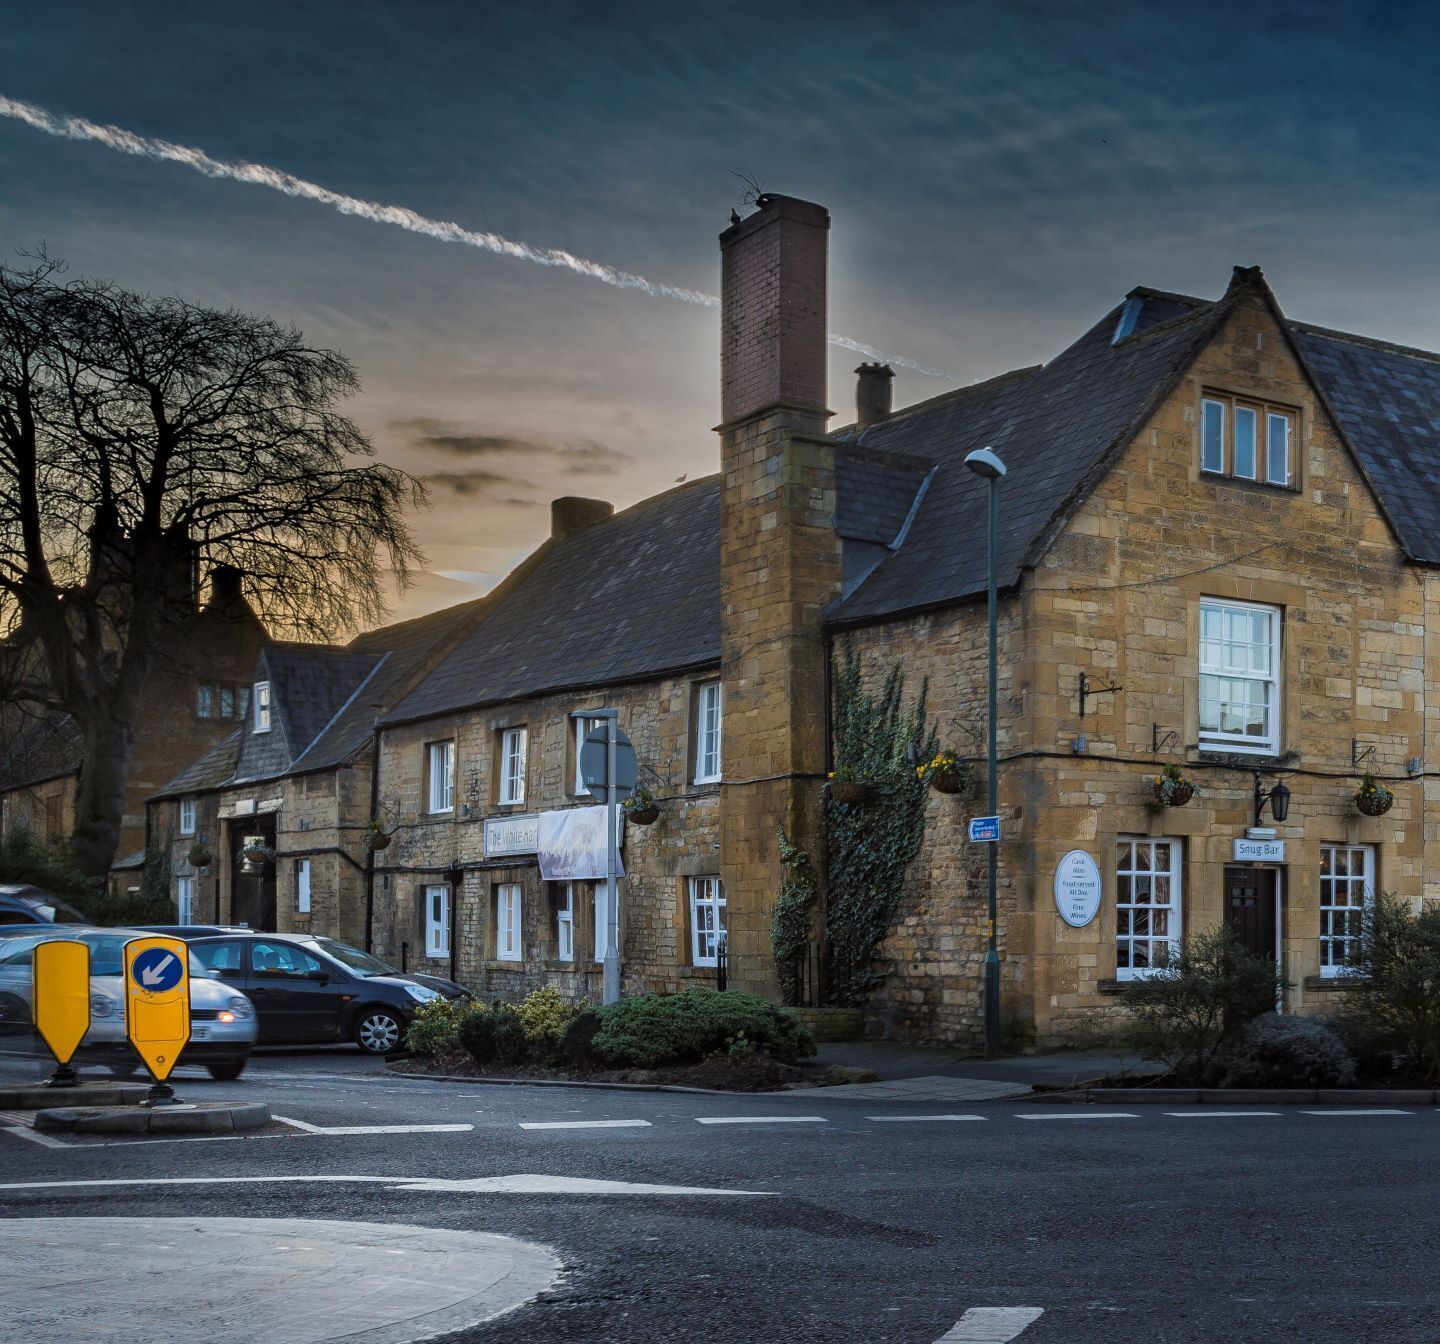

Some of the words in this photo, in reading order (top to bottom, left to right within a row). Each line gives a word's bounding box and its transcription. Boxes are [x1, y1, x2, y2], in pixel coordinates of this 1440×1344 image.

[489, 829, 501, 846] The
[502, 826, 523, 845] White
[523, 828, 537, 843] Har
[1239, 843, 1262, 857] Snug
[1264, 844, 1280, 855] Bar
[1062, 880, 1076, 888] Food
[1076, 880, 1095, 888] served
